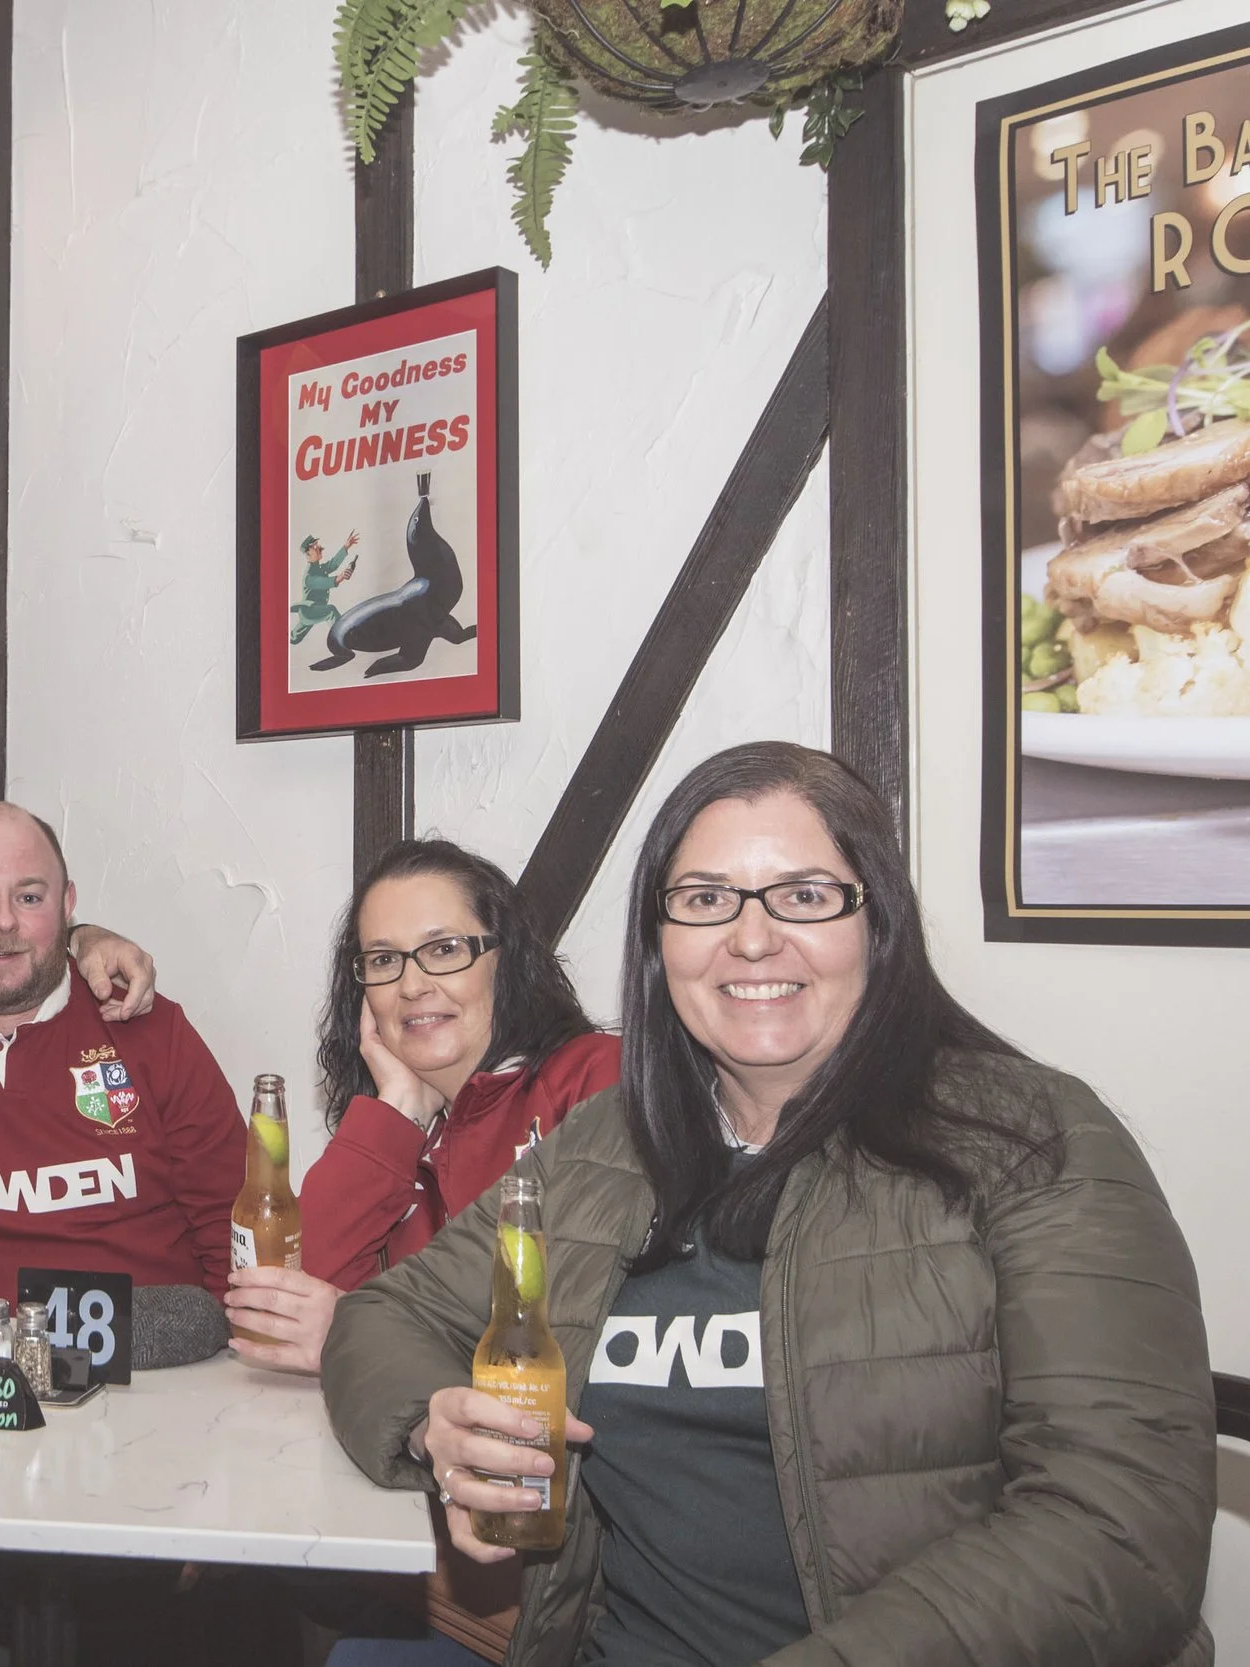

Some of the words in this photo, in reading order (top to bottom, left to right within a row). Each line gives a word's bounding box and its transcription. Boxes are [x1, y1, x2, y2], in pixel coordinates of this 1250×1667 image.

[1051, 139, 1152, 216] THE
[298, 381, 332, 412] My
[341, 353, 467, 399] Goodness
[359, 399, 400, 428] MY
[295, 414, 470, 481] GUINNESS
[46, 1287, 116, 1366] 48
